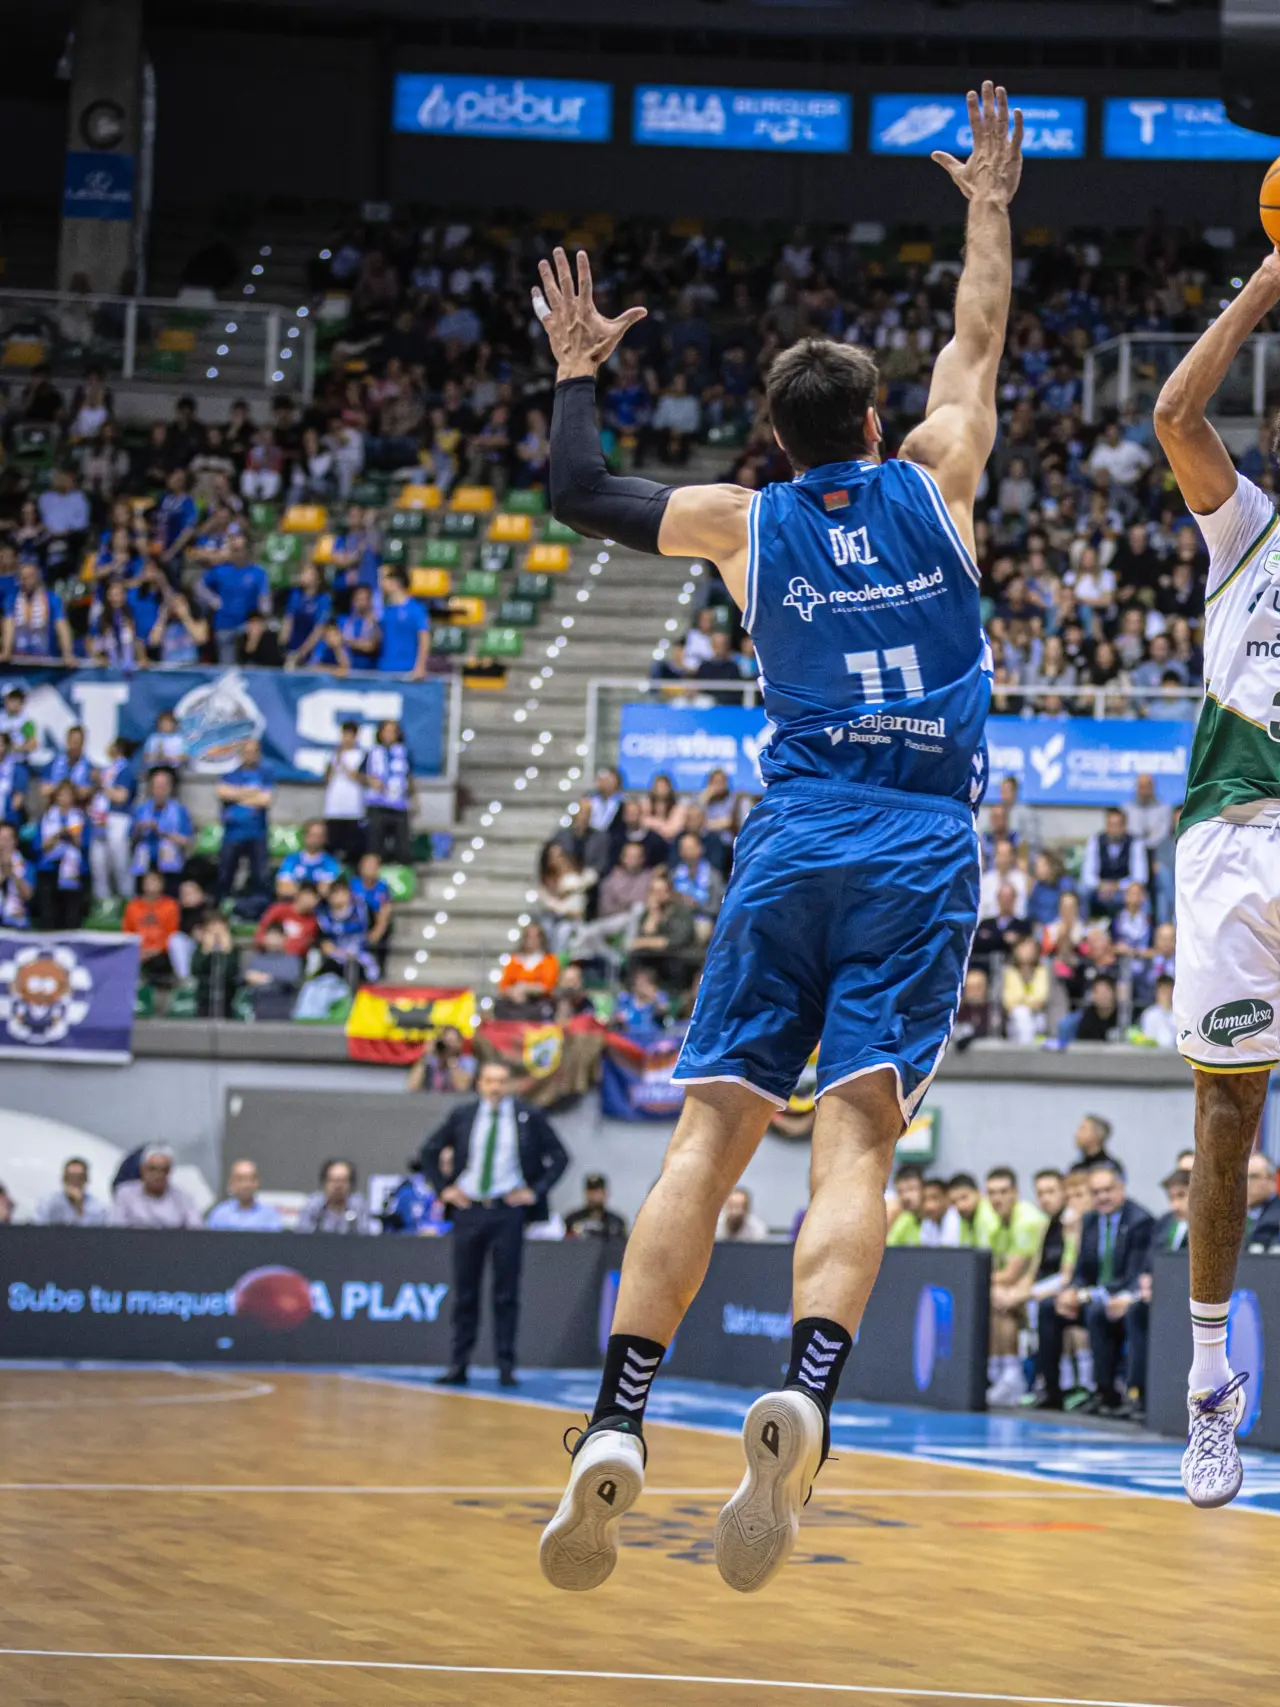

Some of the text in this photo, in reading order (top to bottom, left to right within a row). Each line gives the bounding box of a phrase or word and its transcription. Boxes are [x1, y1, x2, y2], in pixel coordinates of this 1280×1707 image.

[455, 81, 586, 129] pisbur
[829, 566, 943, 603] recoletas salud
[845, 644, 924, 704] 11
[848, 732, 892, 745] Burgos
[1205, 1003, 1272, 1036] famadesa
[8, 1281, 84, 1313] Sube
[90, 1286, 121, 1314] tu
[126, 1289, 237, 1322] maquet
[341, 1282, 448, 1322] PLAY
